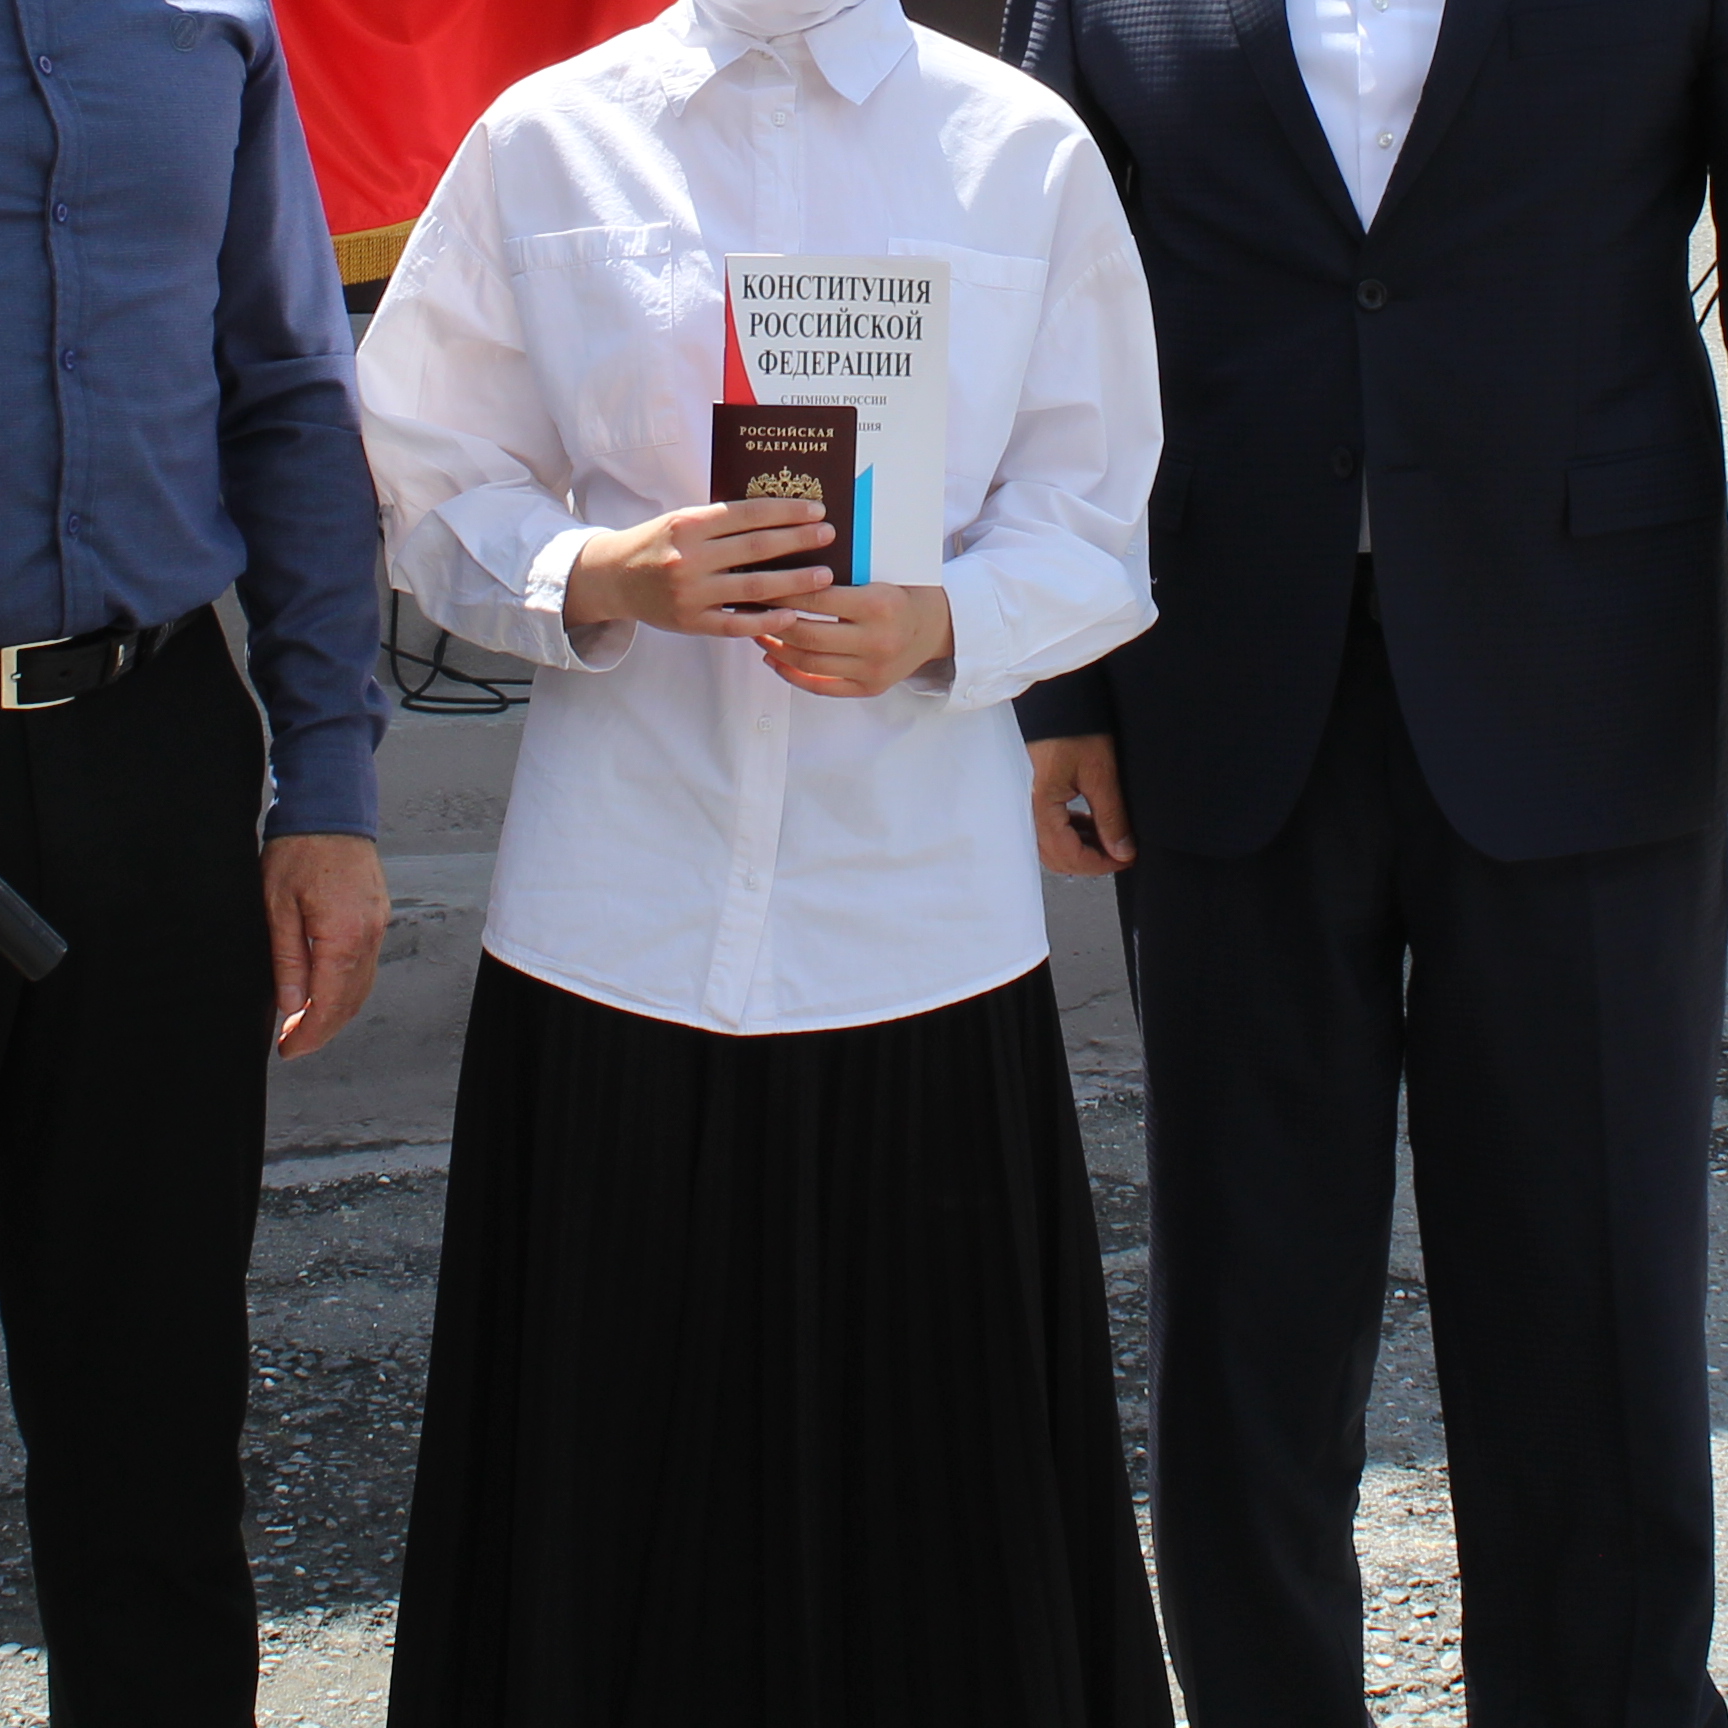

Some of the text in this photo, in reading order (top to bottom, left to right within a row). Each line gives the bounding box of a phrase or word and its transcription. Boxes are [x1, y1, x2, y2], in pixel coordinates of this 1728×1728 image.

[742, 274, 932, 307] КОНСТИТУЦИЯ
[749, 307, 923, 341] РОССИЙСКОЙ
[758, 349, 912, 382] ФЕДЕРАЦИИ
[791, 395, 840, 406] ГИМНОМ
[843, 395, 887, 406] РОССИИ
[739, 425, 834, 438] РОССИЙСКАЯ
[745, 440, 828, 454] ФЕДЕРАЦИЯ
